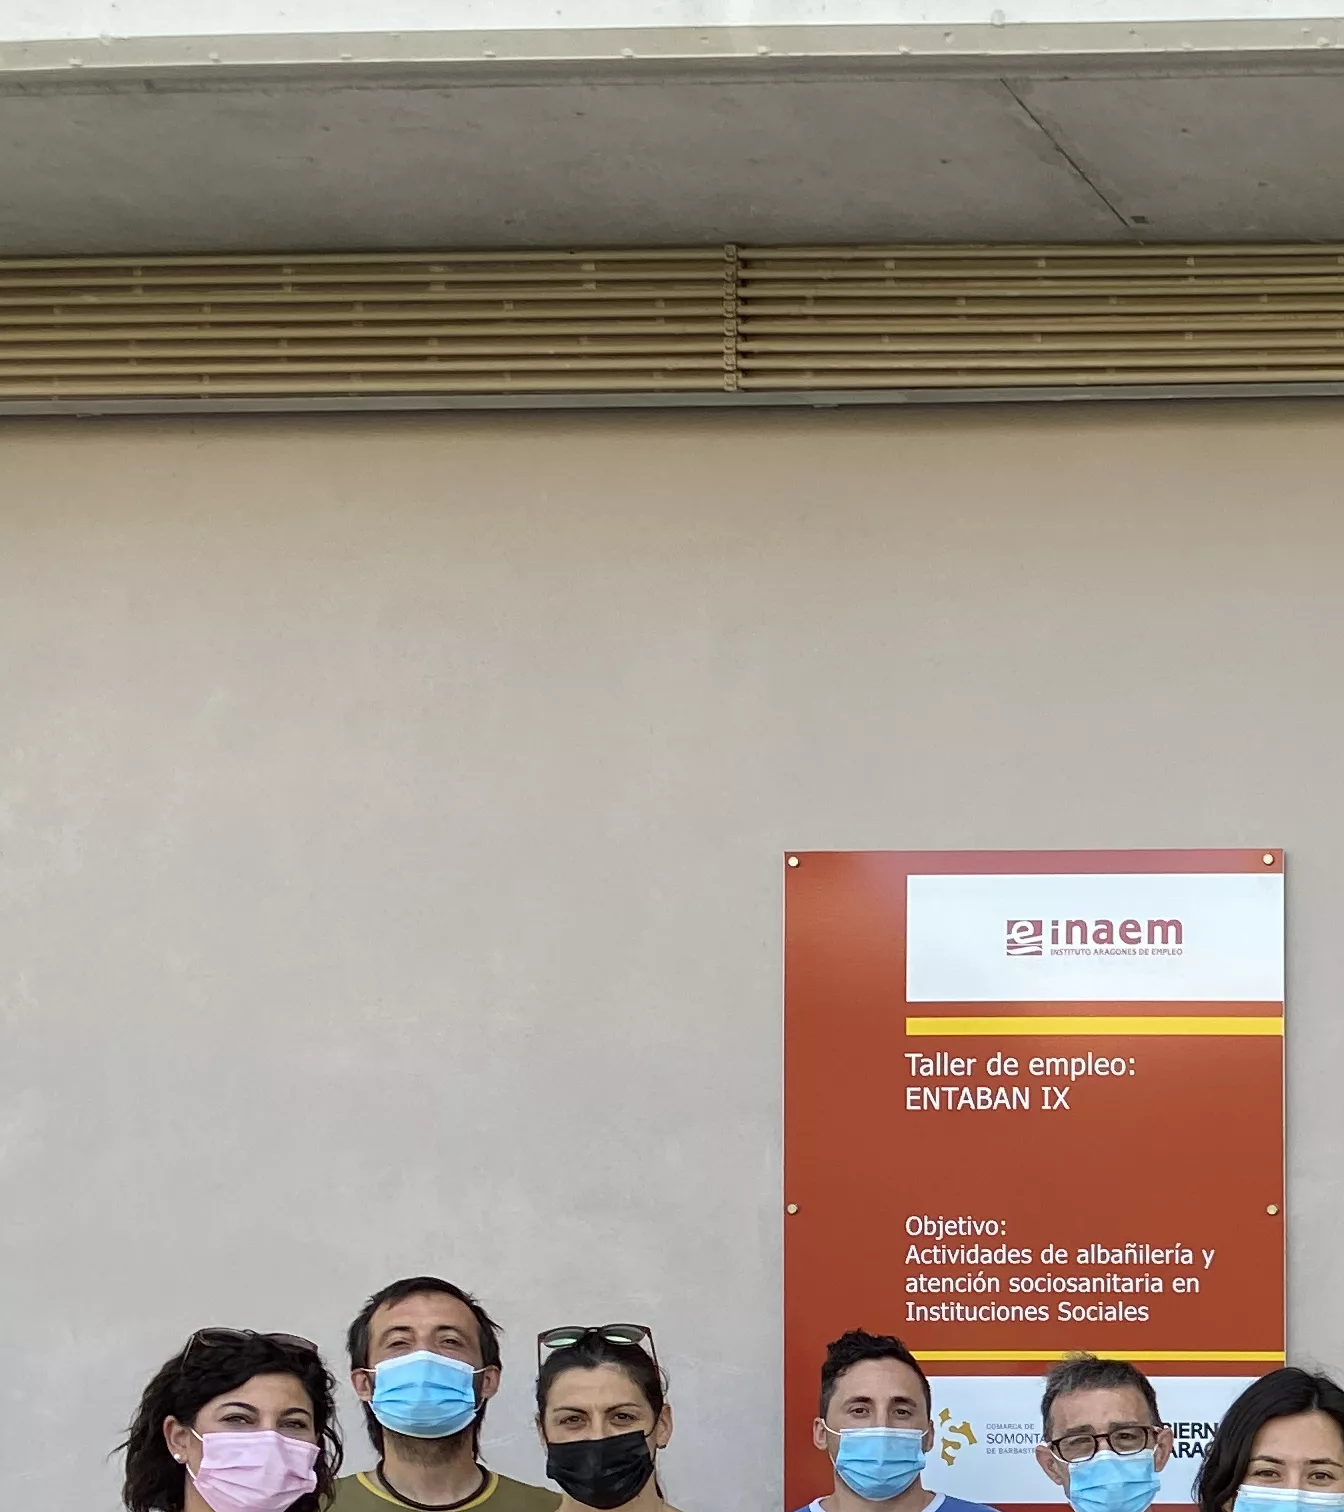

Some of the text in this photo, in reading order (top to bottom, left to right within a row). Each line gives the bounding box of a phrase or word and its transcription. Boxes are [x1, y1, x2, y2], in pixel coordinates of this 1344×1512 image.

[1051, 919, 1183, 945] inaem
[1050, 948, 1183, 956] INSTITUTO ARAGONES DE EMPLEO
[904, 1052, 1136, 1082] Taller de empleo:
[906, 1086, 1071, 1111] ENTABAN IX
[905, 1215, 1007, 1240] Objetivo:
[905, 1243, 1215, 1269] Actividades de albañilería y
[905, 1271, 1200, 1293] atención sociosanitaria en
[905, 1300, 1149, 1322] Instituciones Sociales
